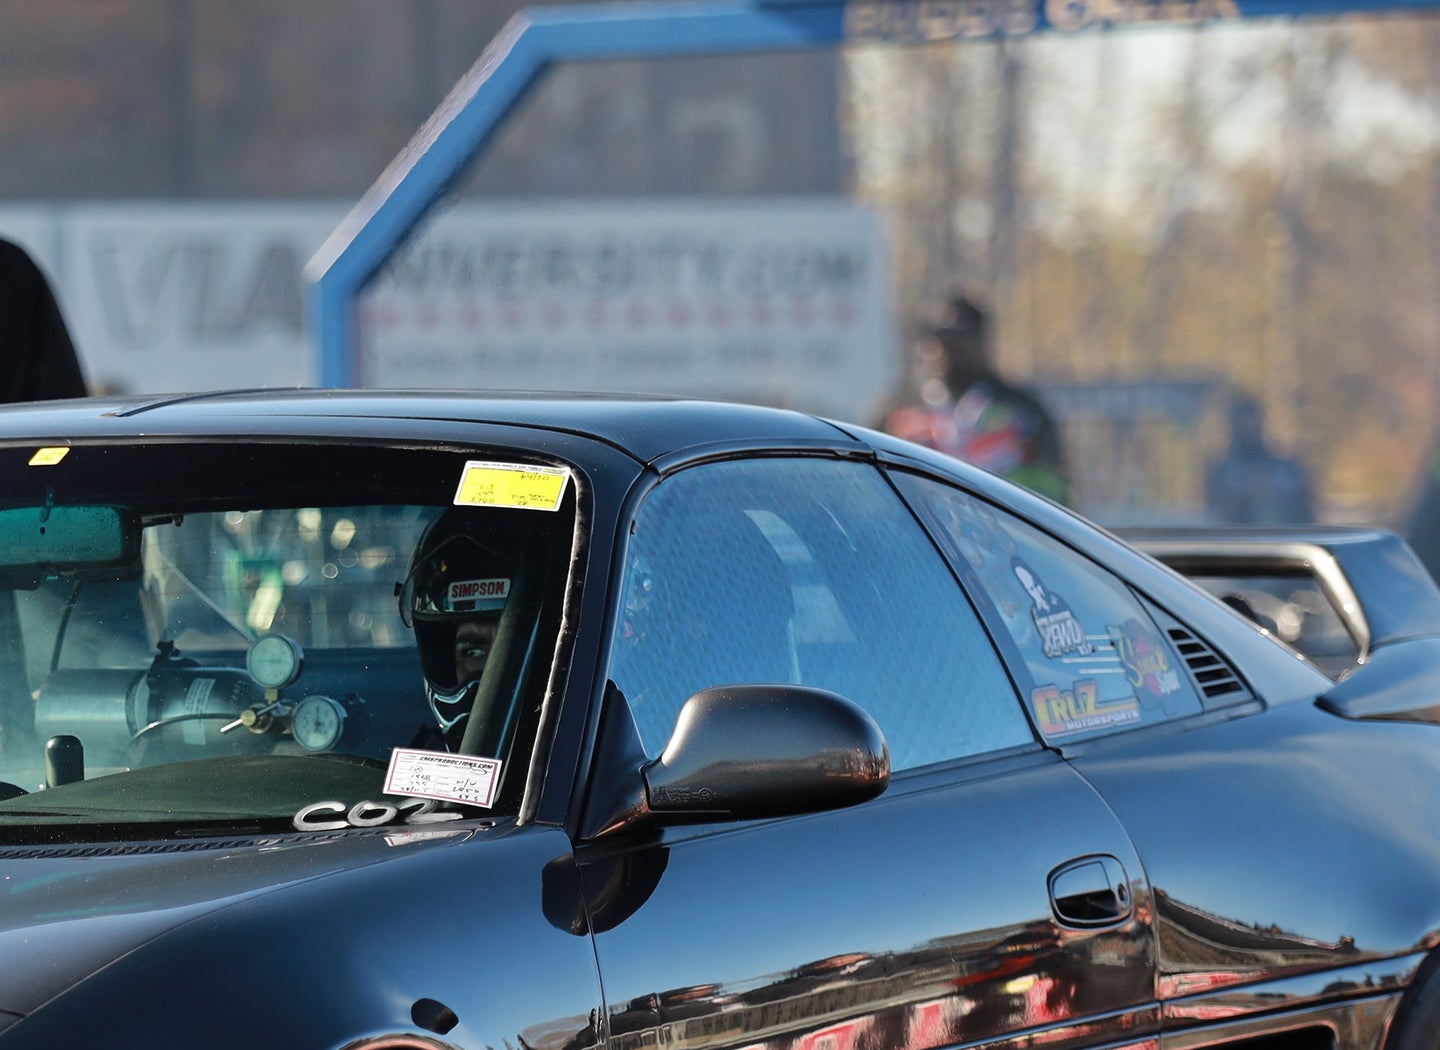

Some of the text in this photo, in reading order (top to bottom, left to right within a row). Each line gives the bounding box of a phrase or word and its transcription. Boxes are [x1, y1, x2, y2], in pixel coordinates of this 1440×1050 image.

[451, 580, 505, 599] SIMPSON
[1032, 680, 1099, 736] CRUZ
[1065, 710, 1140, 730] MOTORSPORTS
